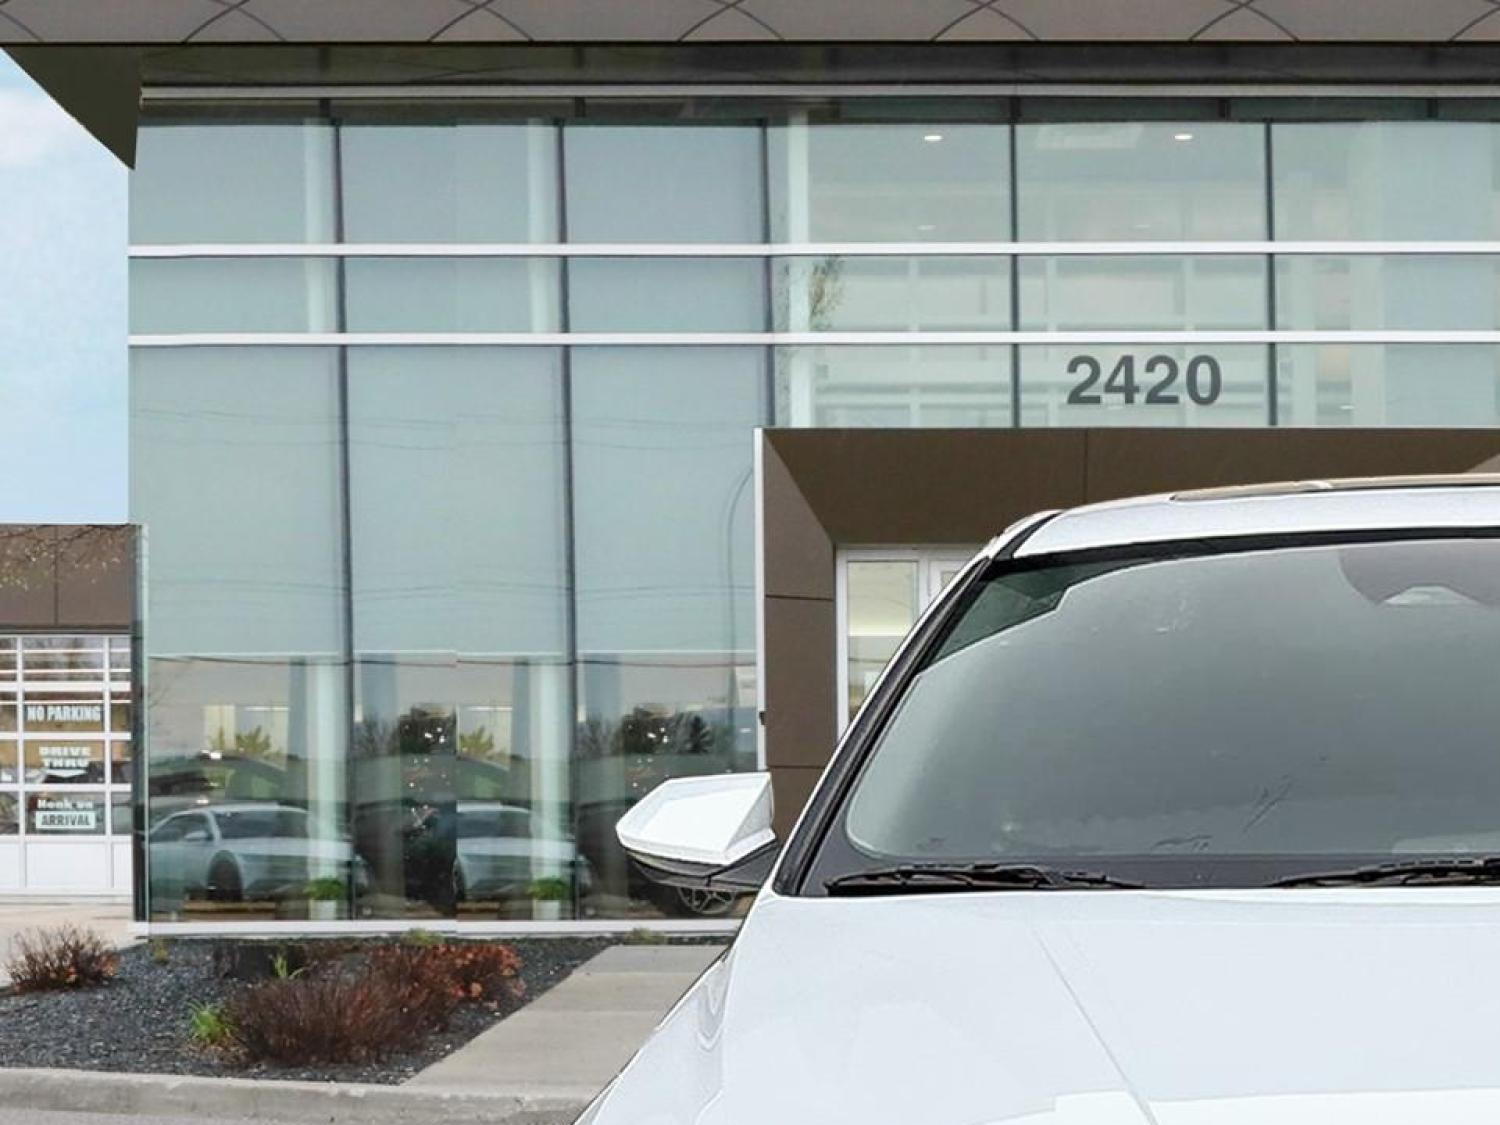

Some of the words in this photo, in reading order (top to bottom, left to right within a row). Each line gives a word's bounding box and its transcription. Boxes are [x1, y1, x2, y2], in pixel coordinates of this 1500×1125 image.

[1067, 355, 1222, 405] 2420
[27, 705, 45, 721] NO
[47, 705, 100, 721] PARKING
[39, 746, 91, 757] DRIVE
[41, 813, 91, 826] ARRIVAL
